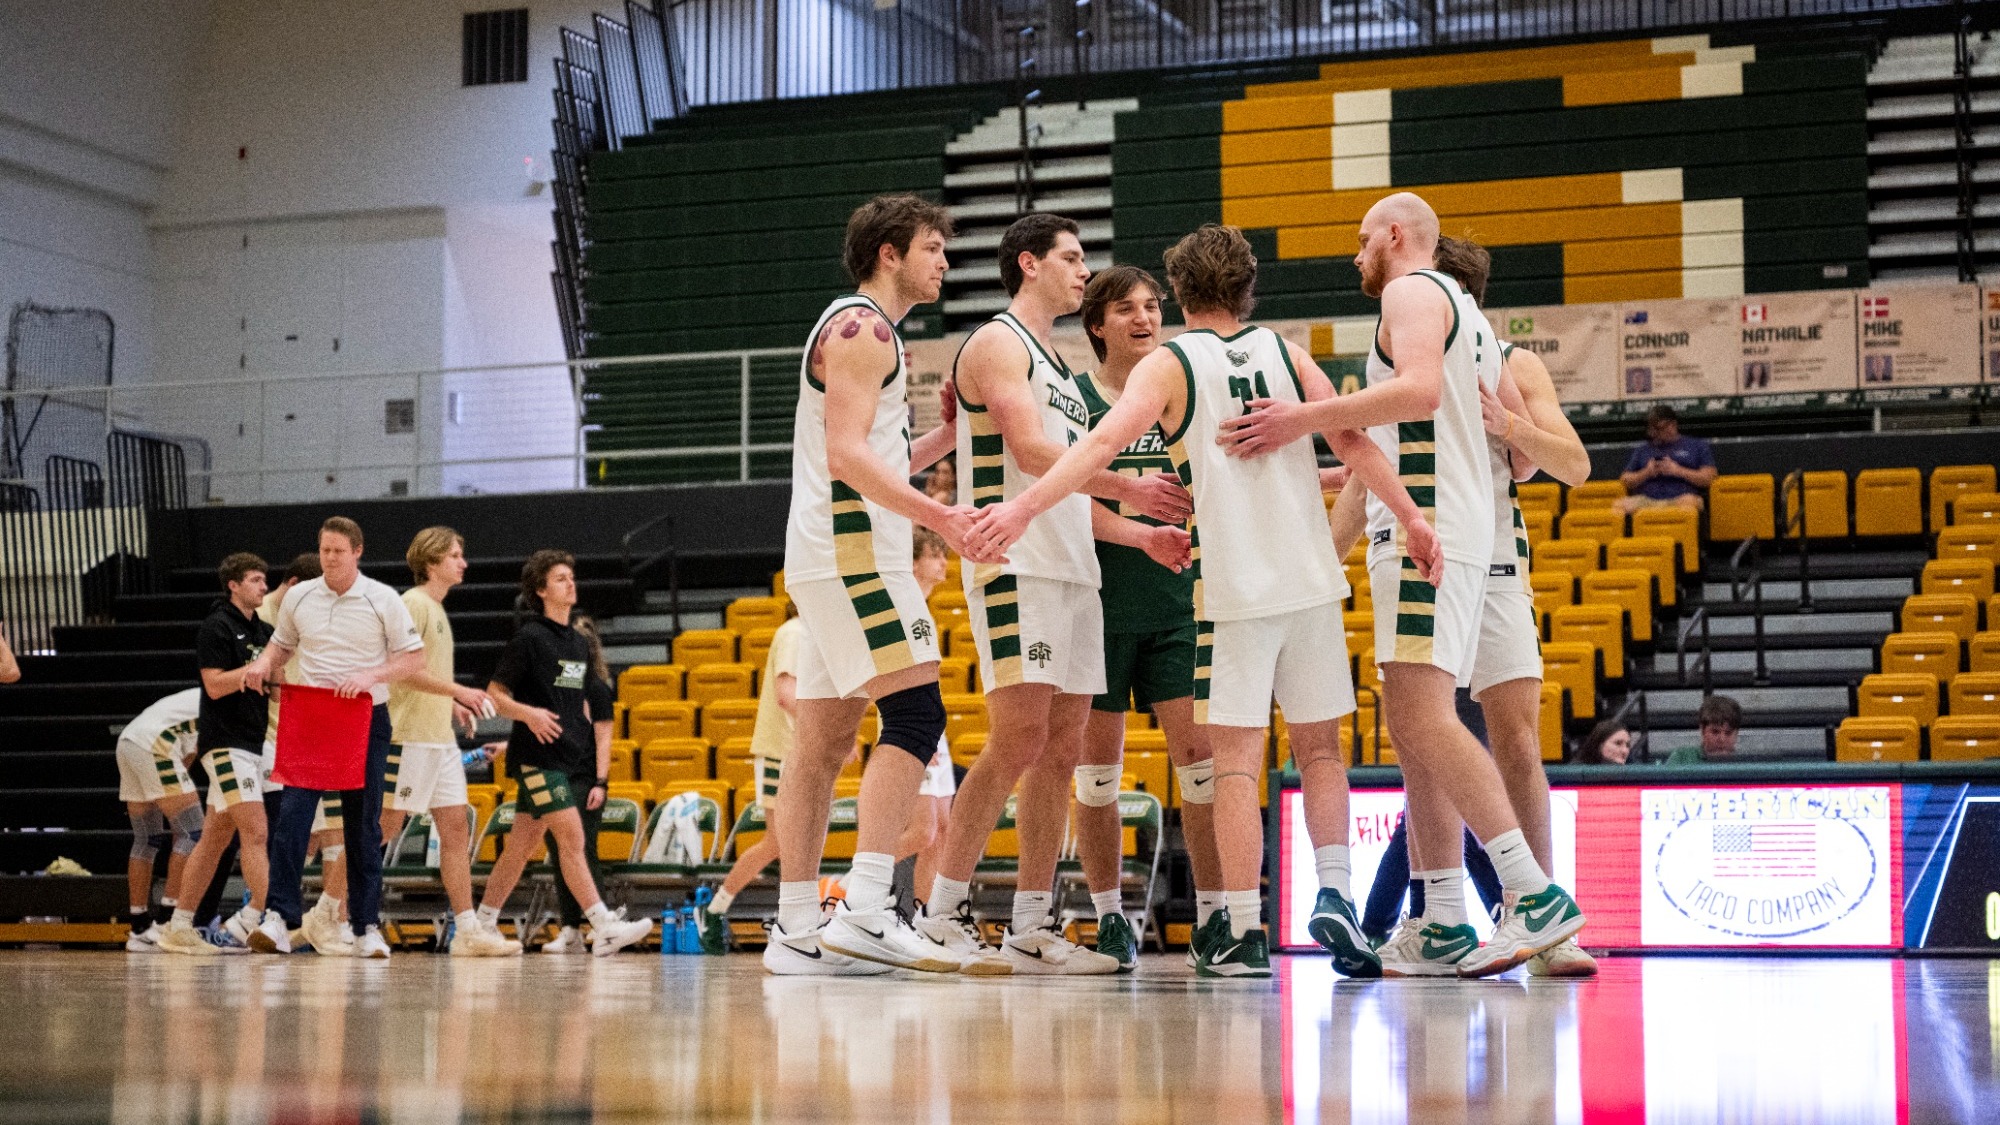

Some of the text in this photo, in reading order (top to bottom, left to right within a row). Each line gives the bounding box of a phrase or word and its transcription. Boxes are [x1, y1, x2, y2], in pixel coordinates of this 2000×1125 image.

[1625, 331, 1689, 350] CONNOR
[1742, 324, 1823, 342] NATHALIE
[1864, 320, 1902, 336] MIKE
[1050, 386, 1086, 424] MNERS
[1642, 789, 1888, 820] AMERICAN
[1686, 877, 1846, 925] TACO COMPANY
